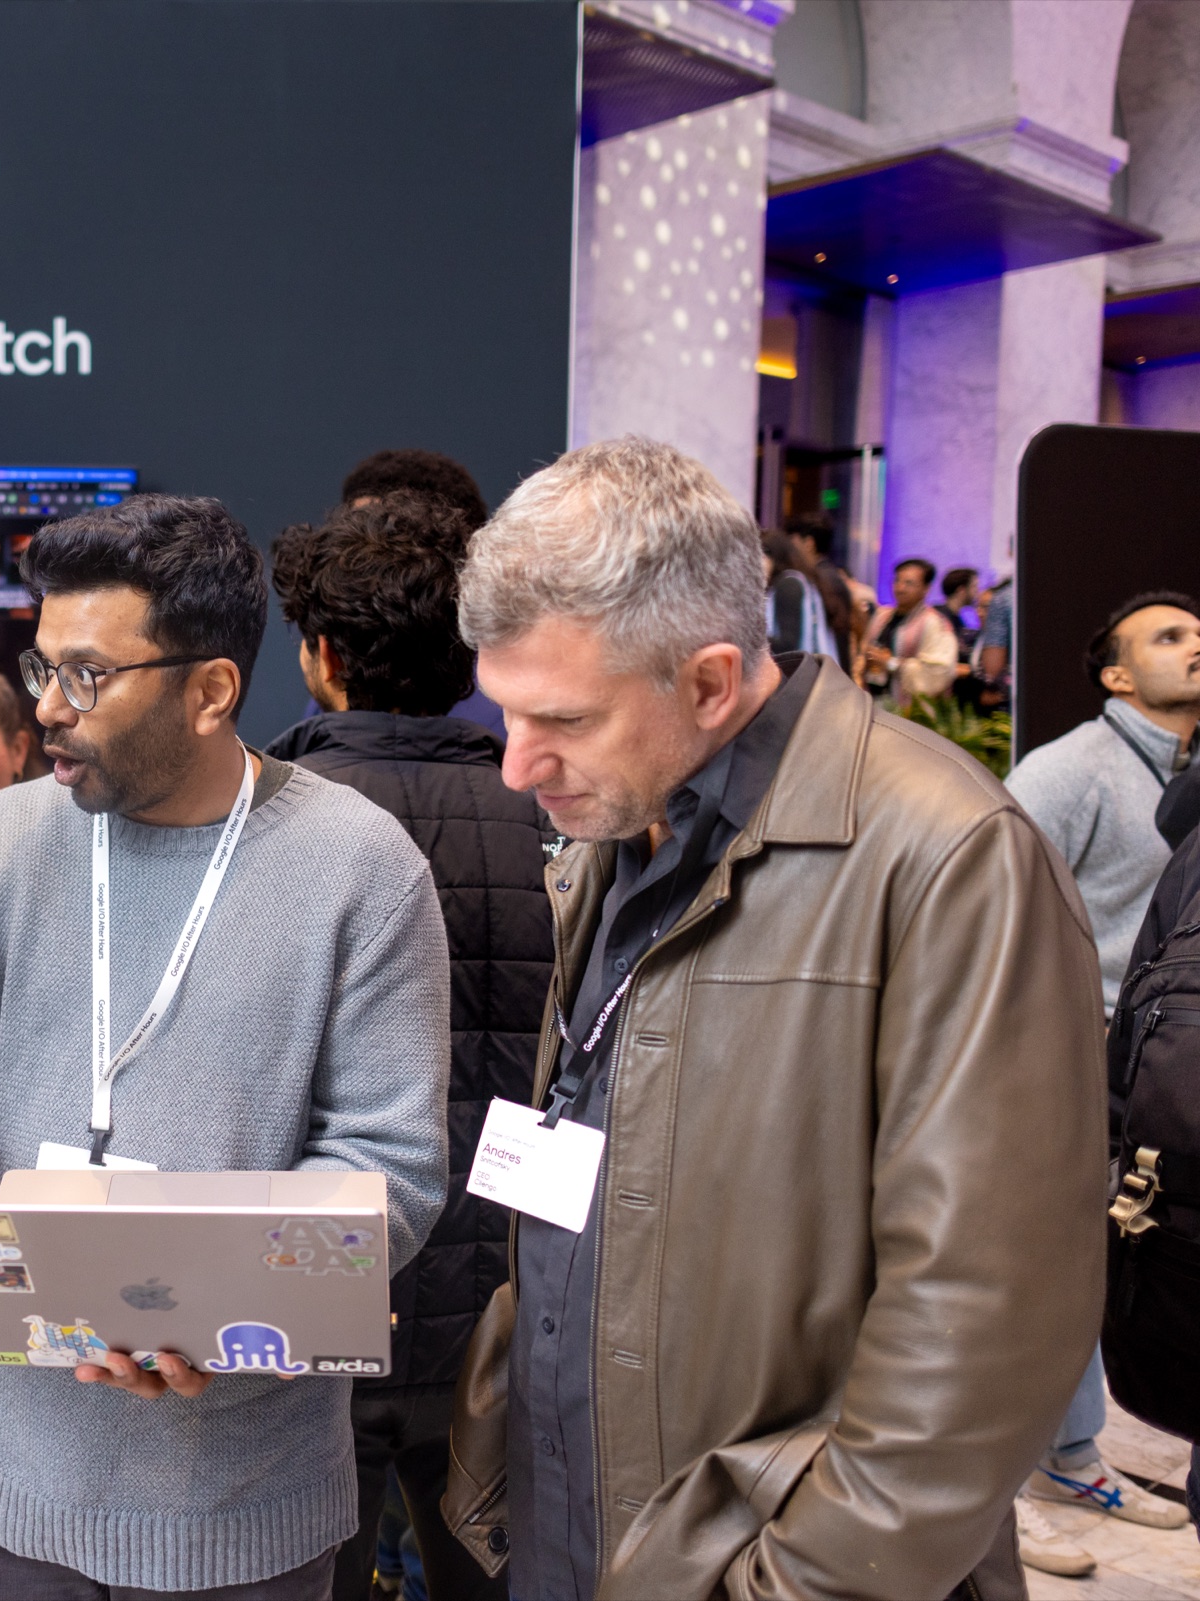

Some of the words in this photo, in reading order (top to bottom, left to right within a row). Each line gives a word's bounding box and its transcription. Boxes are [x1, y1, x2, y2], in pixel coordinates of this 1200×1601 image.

[235, 798, 248, 818] Hours
[228, 817, 241, 835] After
[224, 833, 233, 846] I/O
[213, 846, 228, 870] Google
[96, 882, 106, 907] Google
[98, 907, 106, 920] I/O
[191, 905, 205, 926] Hours
[98, 920, 106, 938] After
[186, 924, 197, 942] After
[98, 938, 106, 960] Hours
[180, 940, 190, 953] I/O
[170, 952, 186, 977] Google
[96, 999, 106, 1026] Google
[583, 1025, 603, 1052] Google
[596, 1012, 608, 1028] I/O
[604, 994, 619, 1016] After
[98, 1027, 106, 1040] I/O
[119, 1046, 131, 1058] I/O
[129, 1032, 143, 1049] After
[140, 1011, 157, 1033] Hours
[98, 1041, 106, 1059] After
[482, 1142, 522, 1165] Andres
[476, 1170, 490, 1181] CEO
[317, 1358, 380, 1373] aida
